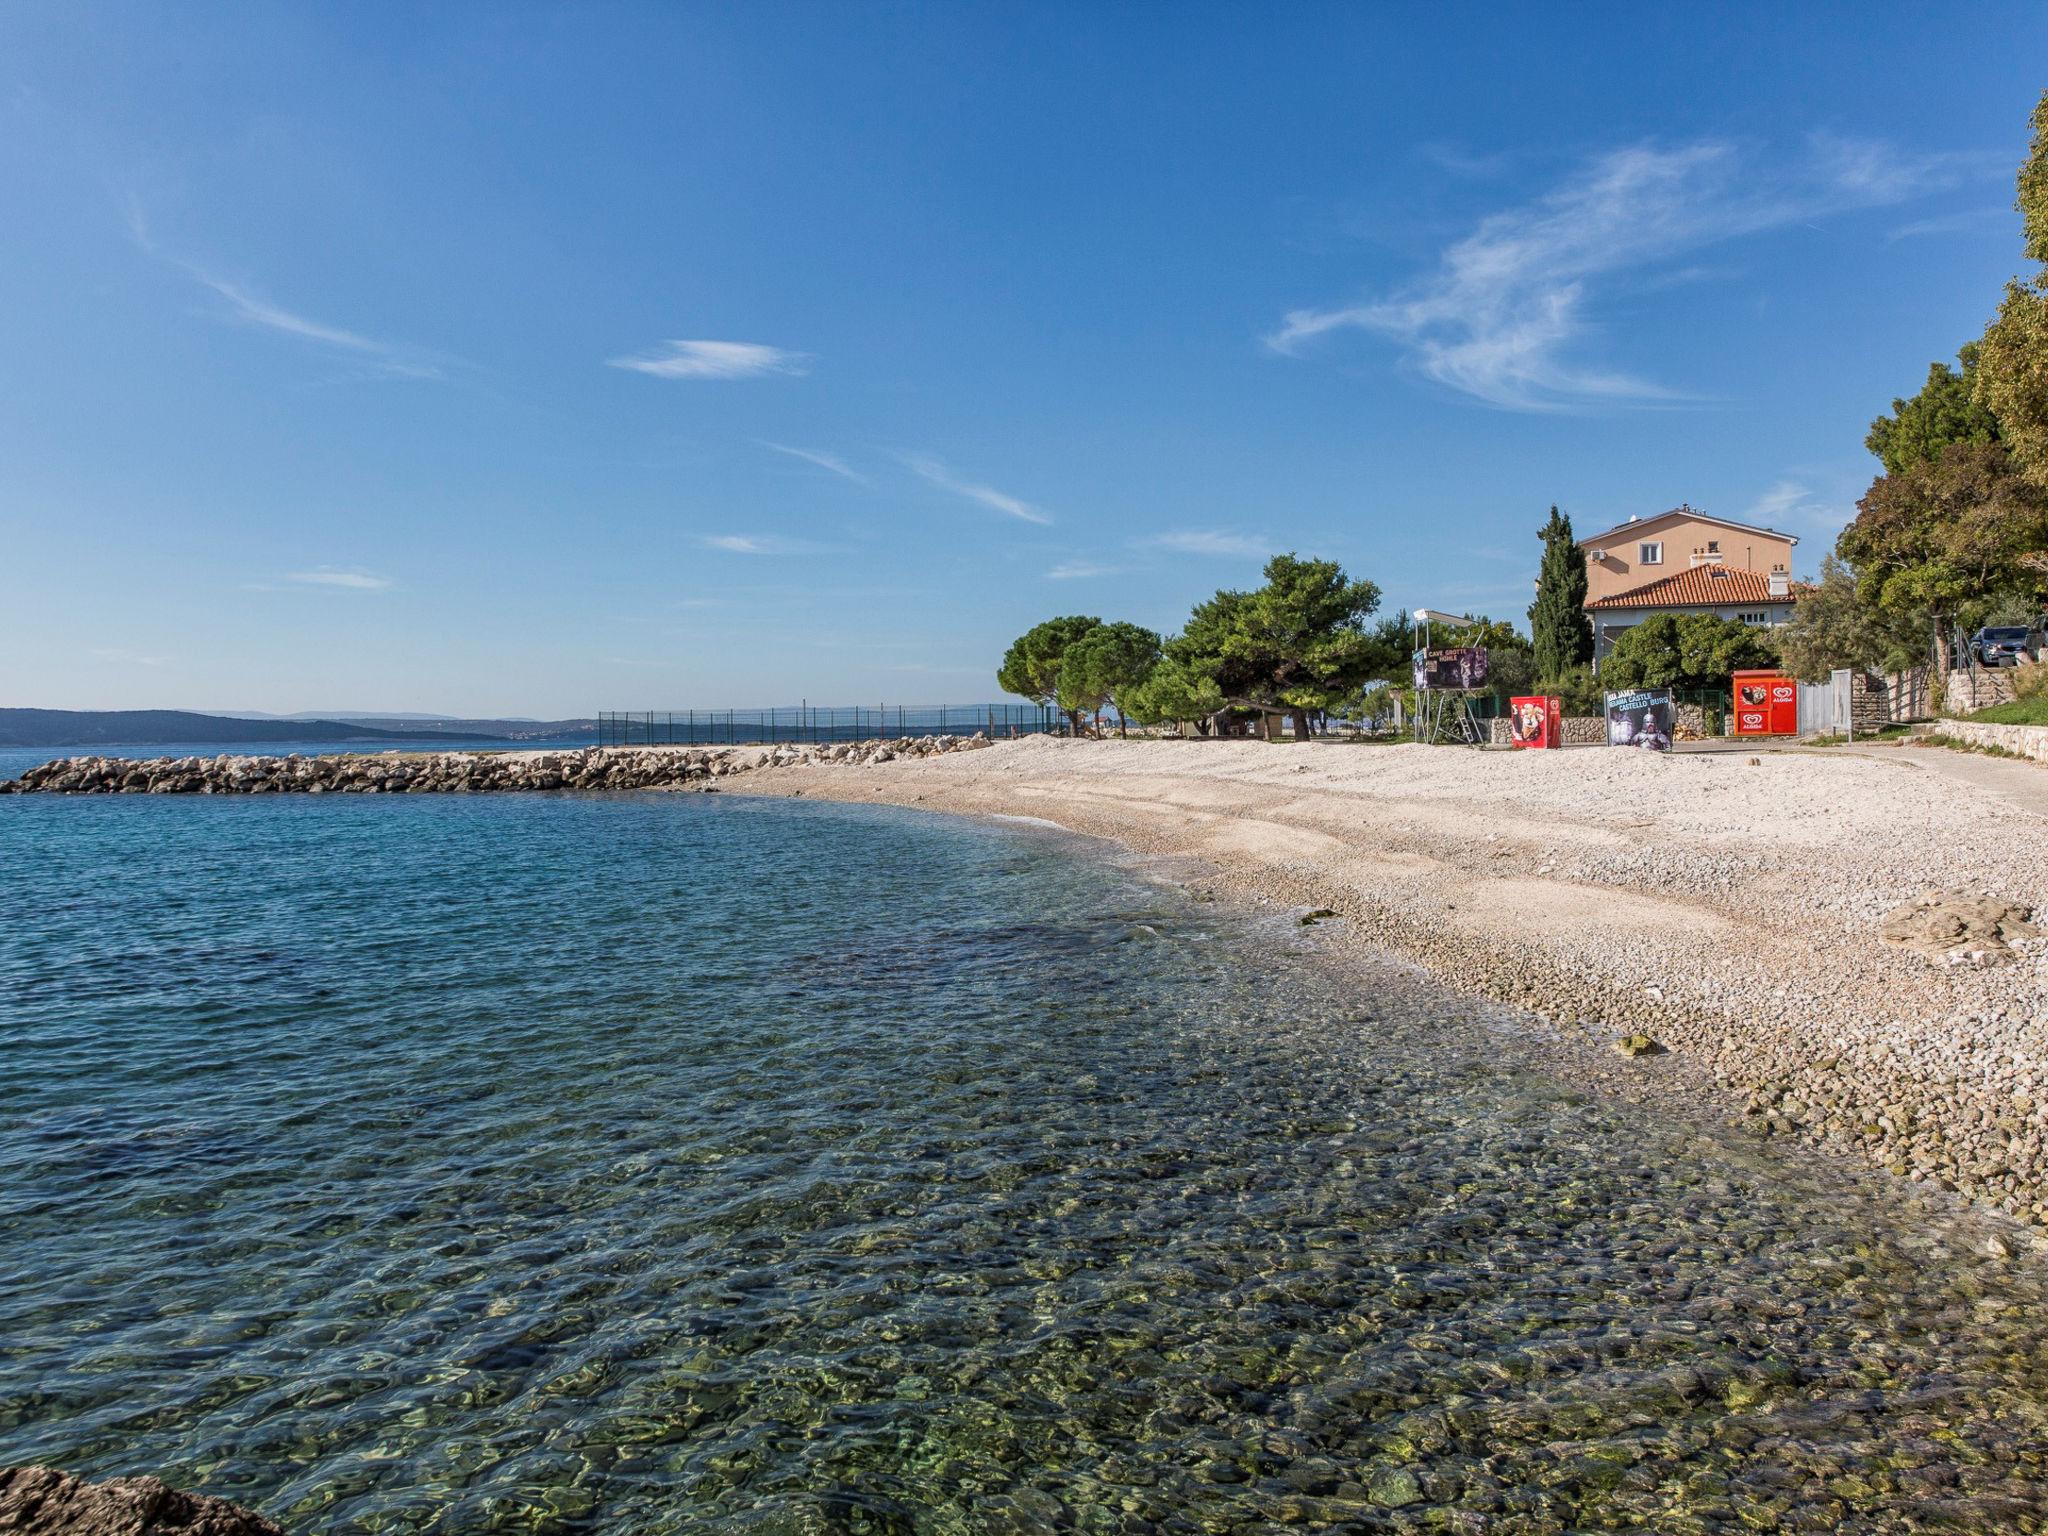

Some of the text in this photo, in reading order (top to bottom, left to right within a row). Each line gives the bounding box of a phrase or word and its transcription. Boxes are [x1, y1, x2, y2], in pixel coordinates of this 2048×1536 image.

[1628, 692, 1652, 702] CASTLE
[1619, 697, 1669, 711] CASTELLO BURG
